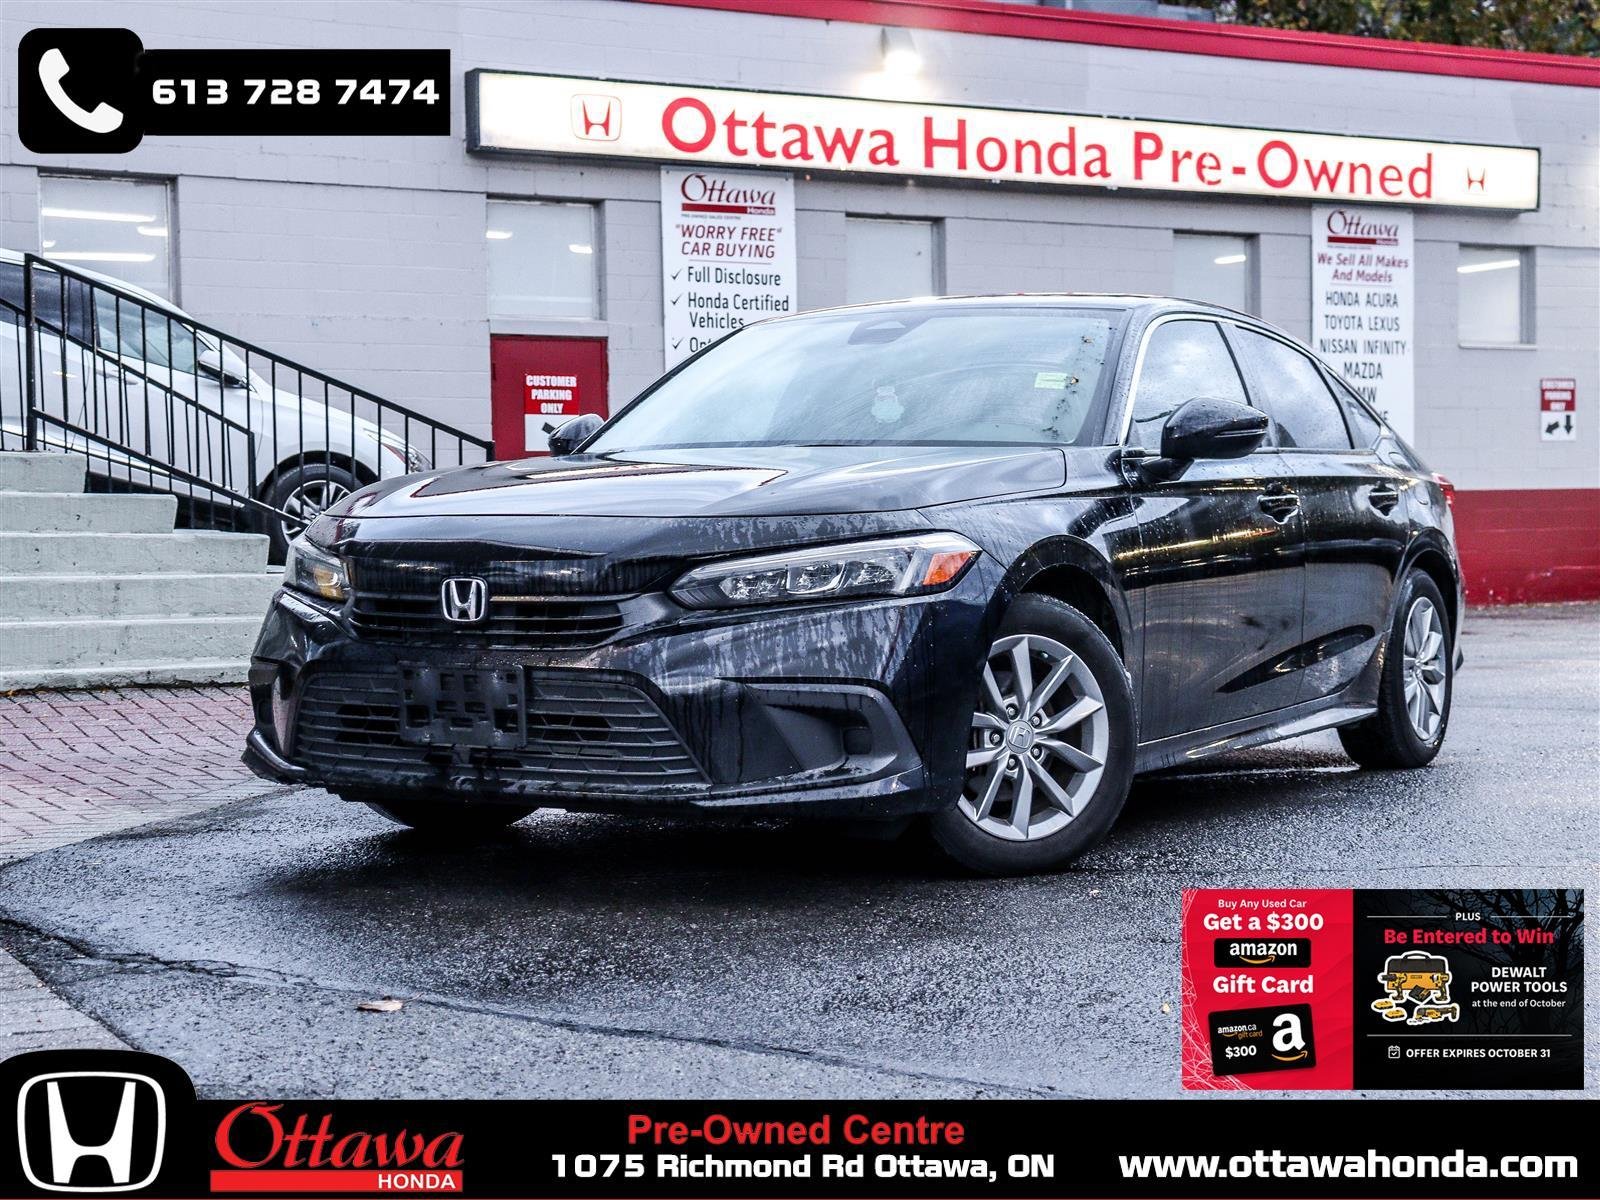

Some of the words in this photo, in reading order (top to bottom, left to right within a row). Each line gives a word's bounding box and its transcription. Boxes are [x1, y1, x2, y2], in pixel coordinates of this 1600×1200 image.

[662, 97, 900, 167] Ottawa
[923, 116, 1111, 179] Honda
[1133, 131, 1433, 199] Pre-Owned
[681, 173, 776, 205] Ottawa
[1327, 209, 1399, 237] Ottawa
[681, 241, 711, 256] CAR
[715, 243, 775, 259] BUYING
[1317, 253, 1333, 265] We
[1336, 253, 1356, 266] Sell
[1358, 254, 1373, 267] All
[1376, 255, 1409, 268] Makes
[688, 266, 710, 283] Full
[715, 268, 781, 286] Disclosure
[1332, 269, 1353, 281] And
[1356, 270, 1393, 283] Models
[688, 292, 729, 309] Honda
[733, 294, 789, 312] Certified
[1326, 291, 1360, 306] HONDA
[1365, 292, 1398, 307] ACURA
[689, 311, 745, 329] Vehicles
[1325, 314, 1363, 330] TOYOTA
[1368, 316, 1400, 331] LEXUS
[1320, 338, 1358, 354] NISSAN
[1363, 339, 1406, 355] INFINITY
[1343, 362, 1383, 379] MAZDA
[526, 375, 577, 387] CUSTOMER
[532, 389, 572, 400] PARKING
[541, 403, 564, 414] ONLY
